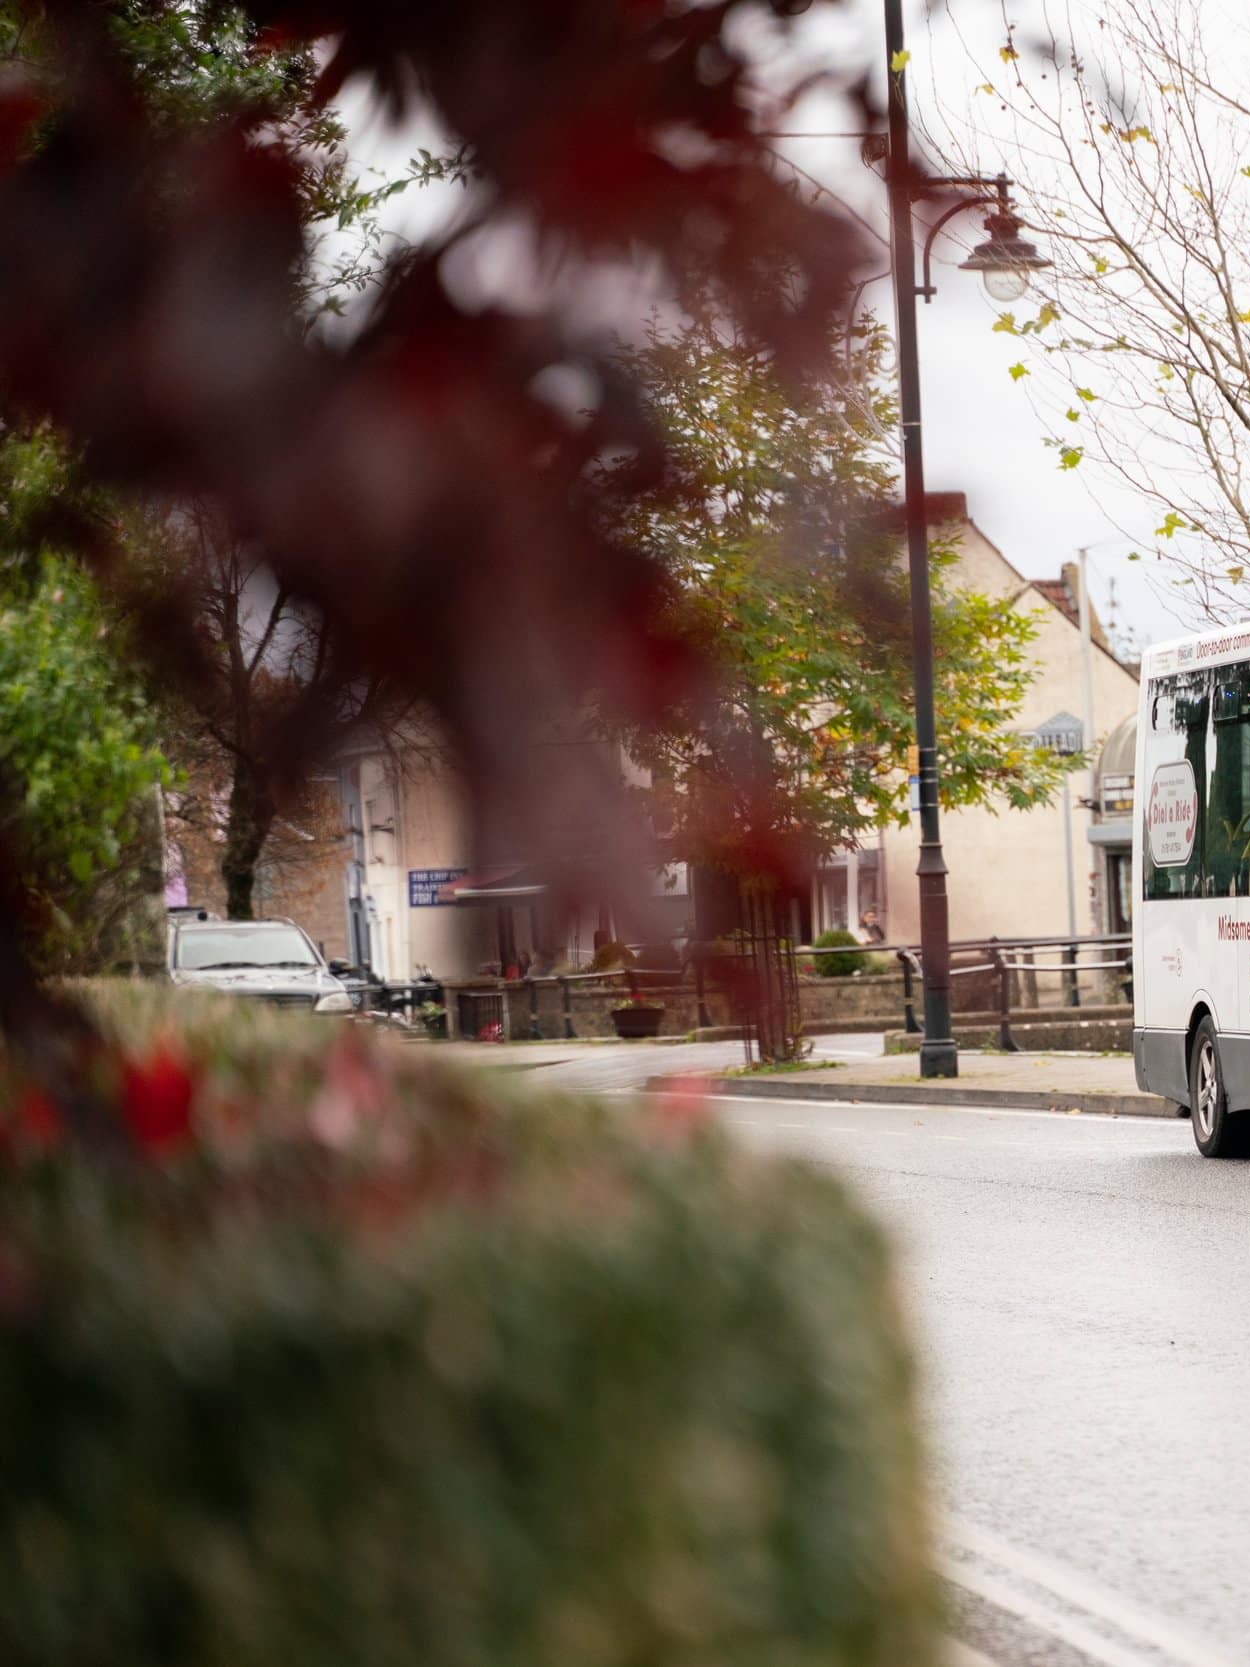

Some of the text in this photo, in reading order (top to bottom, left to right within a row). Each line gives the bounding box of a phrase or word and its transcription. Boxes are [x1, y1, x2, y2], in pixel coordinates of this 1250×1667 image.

[1197, 636, 1233, 659] Door-to-door
[1153, 801, 1168, 825] Dial
[1176, 799, 1191, 823] Ride
